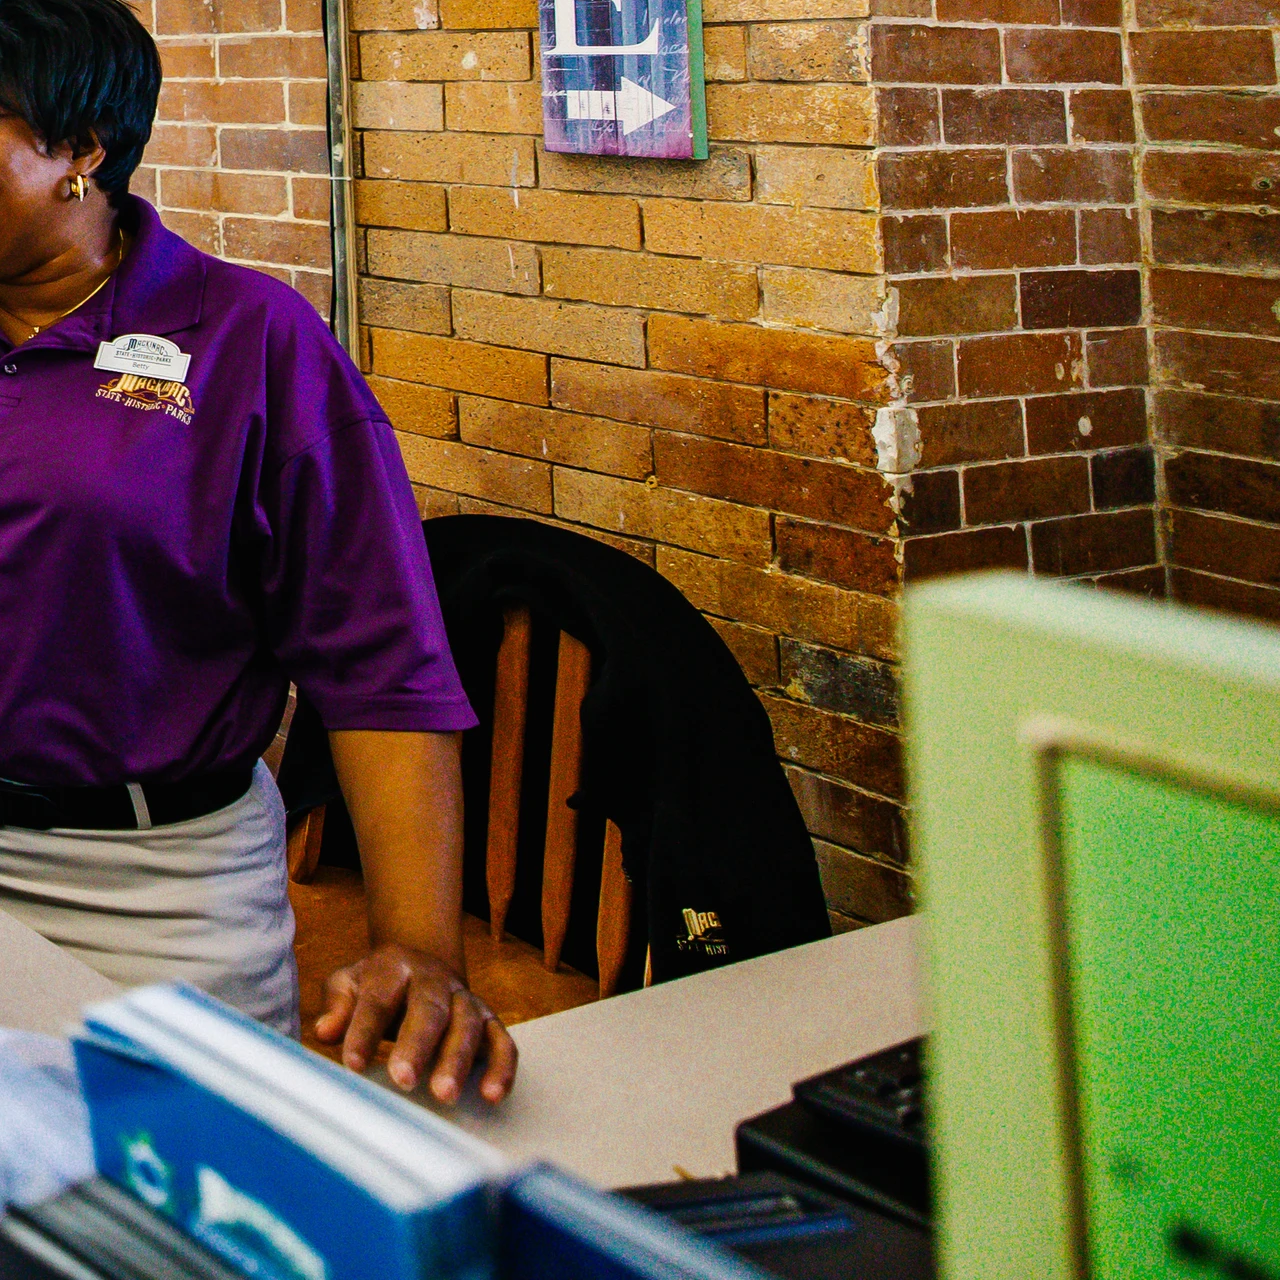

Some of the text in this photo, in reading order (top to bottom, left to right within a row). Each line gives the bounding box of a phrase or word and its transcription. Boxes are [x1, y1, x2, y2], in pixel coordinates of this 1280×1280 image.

[126, 337, 166, 357] MACKINAC
[132, 361, 150, 371] Betty
[95, 388, 123, 403] STATE
[165, 404, 192, 426] PARKS
